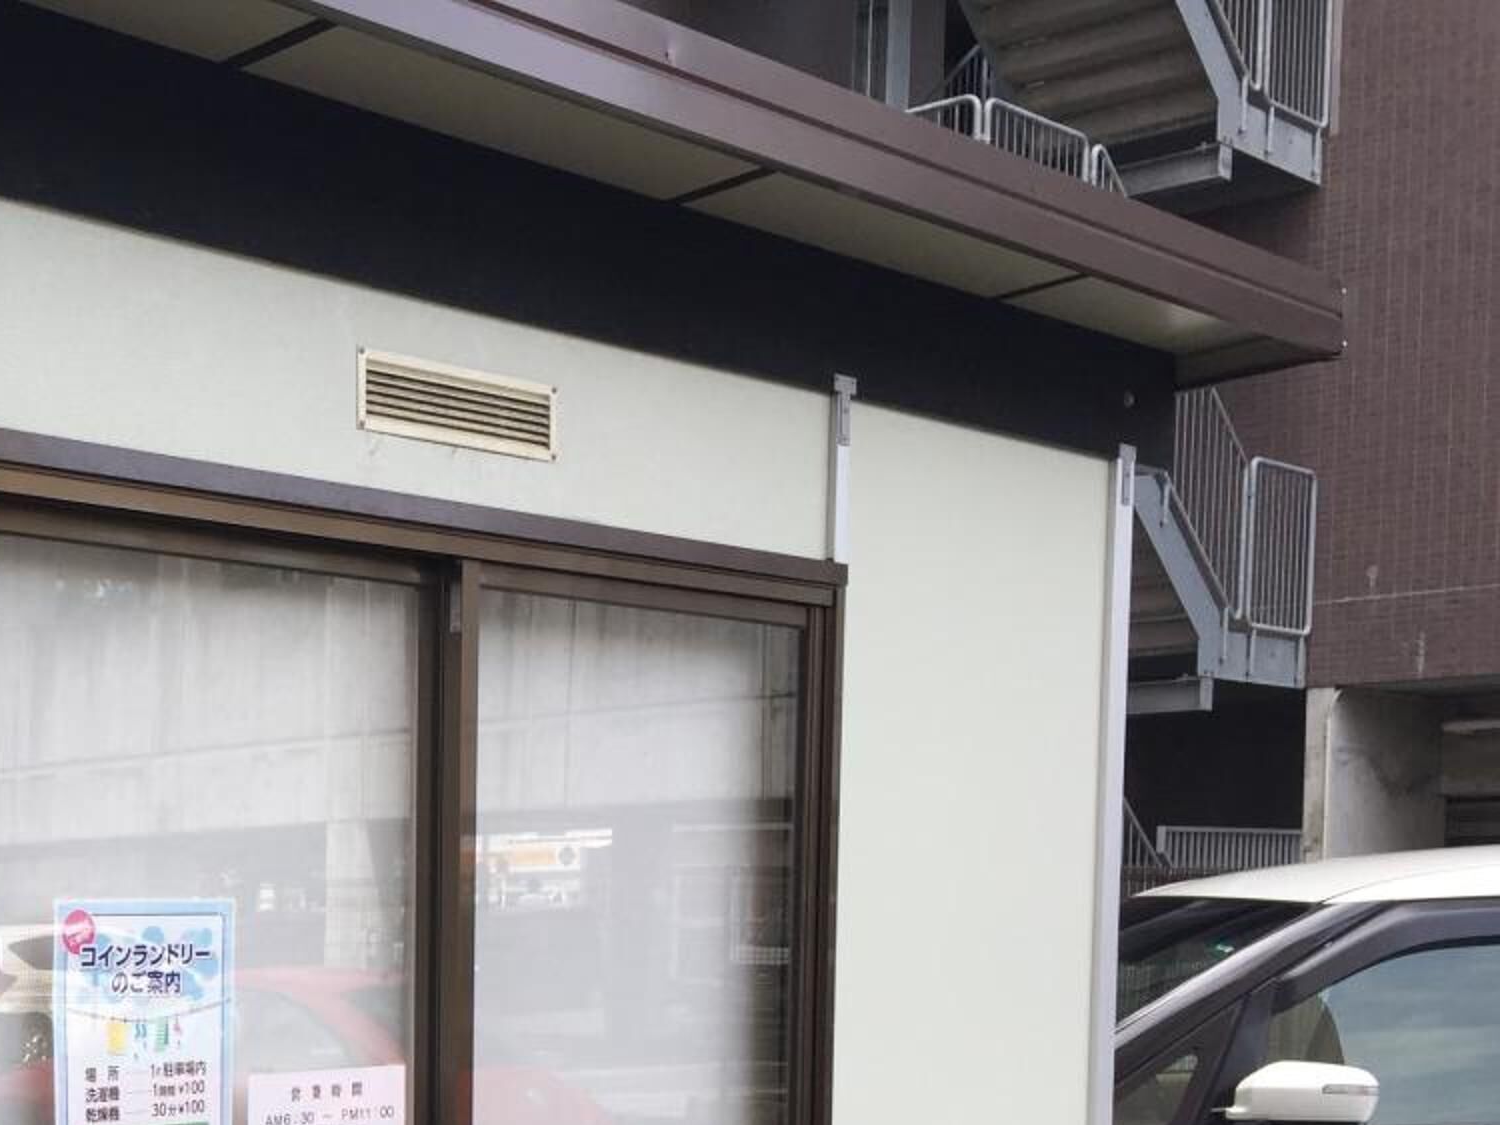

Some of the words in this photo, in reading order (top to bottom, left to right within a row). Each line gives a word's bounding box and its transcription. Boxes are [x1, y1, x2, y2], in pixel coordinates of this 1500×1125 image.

[81, 943, 210, 967] コインランドリー
[111, 971, 181, 994] のご案内
[85, 1085, 120, 1104] 洗濯機
[85, 1106, 120, 1123] 乾燥機
